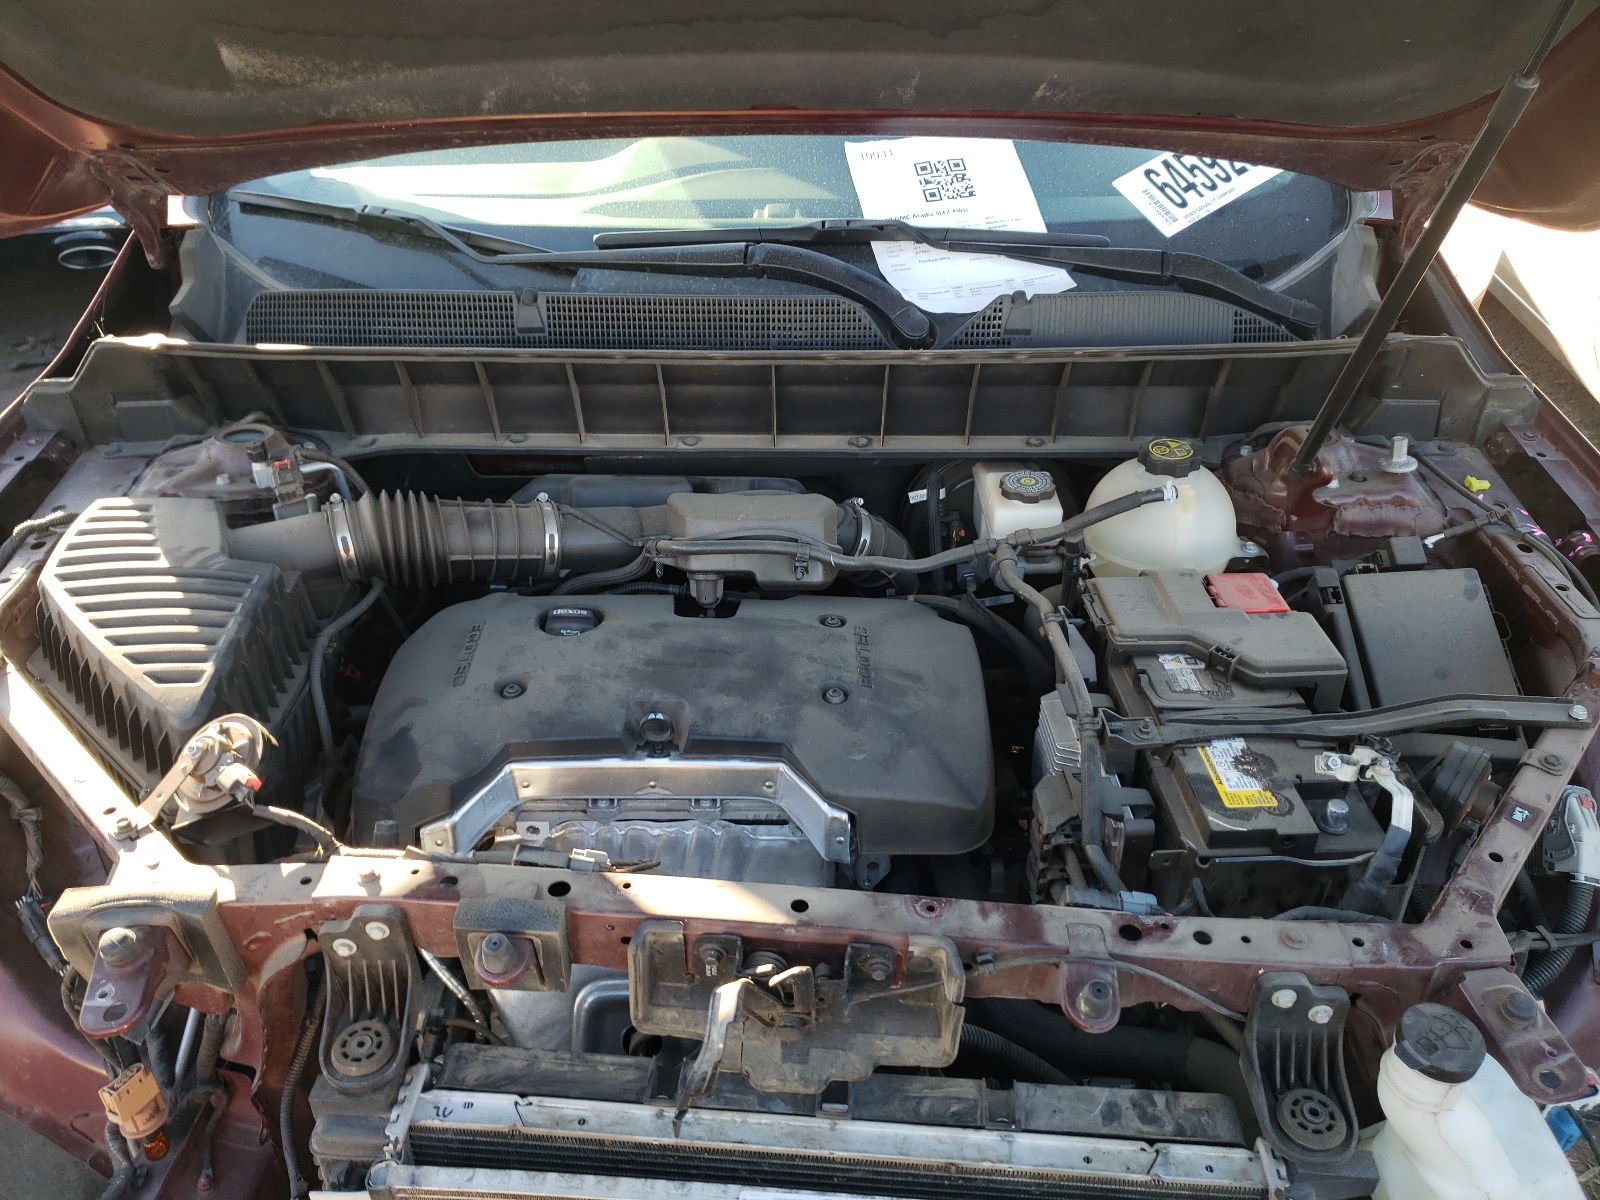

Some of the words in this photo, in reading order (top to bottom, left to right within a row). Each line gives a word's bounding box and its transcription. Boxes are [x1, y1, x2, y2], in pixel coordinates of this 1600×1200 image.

[1143, 153, 1257, 209] 6459
[452, 622, 485, 688] ECOTEC
[855, 627, 873, 689] ECOTEC
